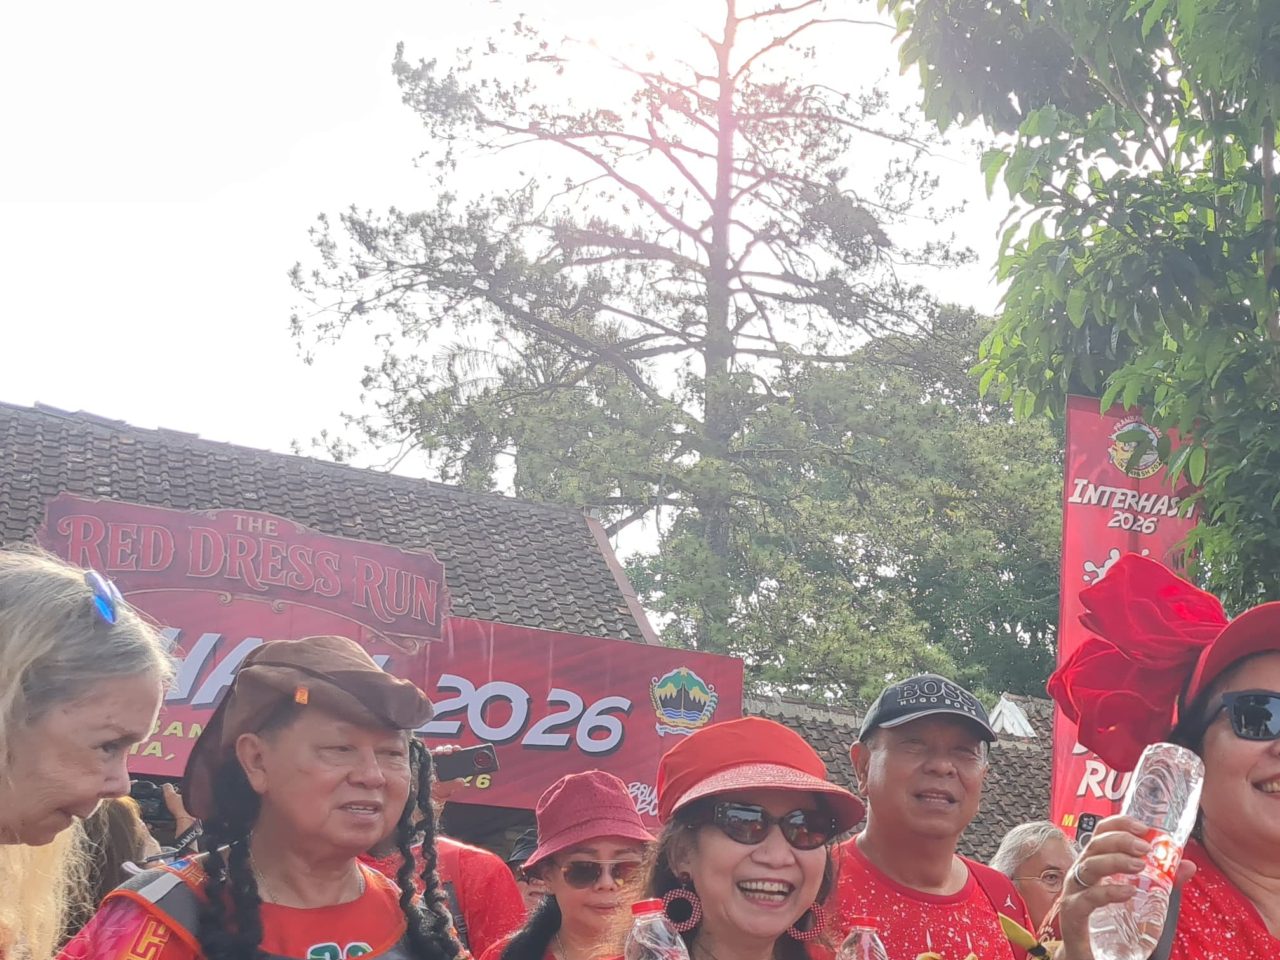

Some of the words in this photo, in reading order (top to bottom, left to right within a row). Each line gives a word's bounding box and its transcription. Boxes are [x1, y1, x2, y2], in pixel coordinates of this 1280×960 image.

[233, 514, 279, 536] THE
[1108, 511, 1157, 534] 2026
[57, 514, 175, 573] RED
[186, 526, 341, 597] DRESS
[351, 555, 439, 626] RUN
[896, 680, 976, 710] BOSS
[900, 697, 937, 706] HUGO
[945, 699, 977, 716] BOSS
[420, 673, 632, 752] 2026
[1076, 759, 1134, 801] RU
